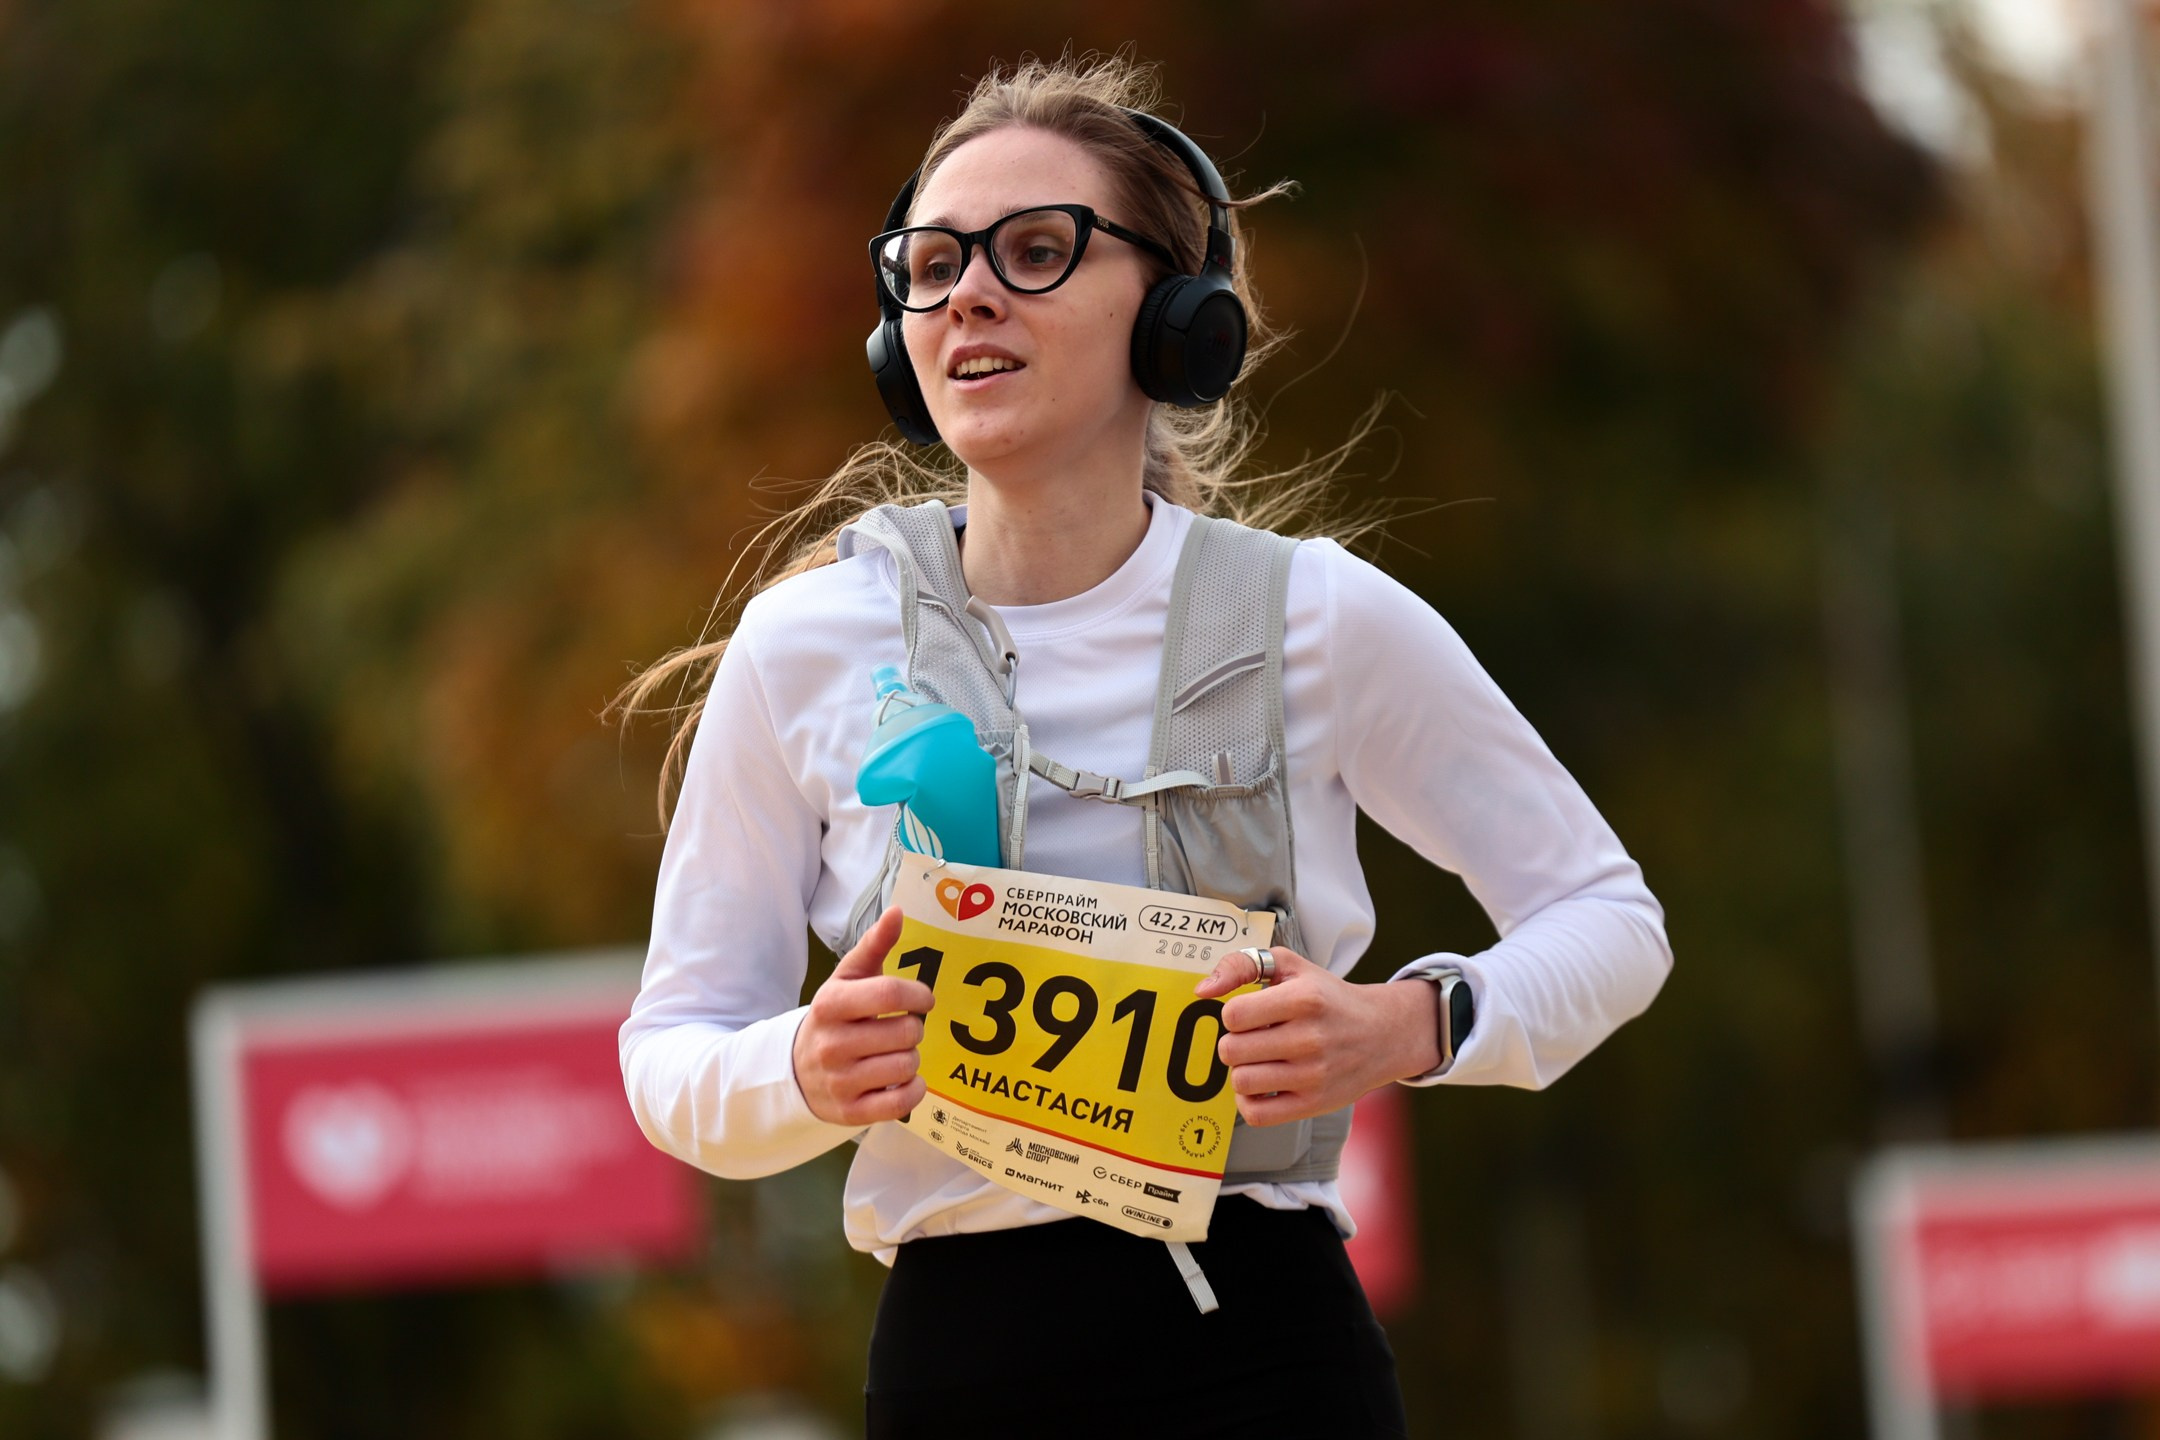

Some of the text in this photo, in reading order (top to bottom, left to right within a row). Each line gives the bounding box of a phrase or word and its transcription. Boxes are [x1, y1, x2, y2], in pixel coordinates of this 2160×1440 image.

[1006, 887, 1098, 909] СБЕРПРАЙМ
[1002, 901, 1128, 931] МОСКОВСКИЙ
[1149, 911, 1191, 931] 42,2
[998, 917, 1094, 945] МАРАФОН
[1155, 938, 1213, 961] 2026
[897, 946, 1231, 1103] 13910
[948, 1062, 1135, 1134] АНАСТАСИЯ
[1178, 1134, 1205, 1158] МАРАФОН
[1194, 1128, 1204, 1145] 1
[1197, 1115, 1221, 1155] МОСКОВСКИЙ
[968, 1153, 993, 1169] BRICS
[1025, 1150, 1051, 1165] СПОРТ
[1028, 1142, 1080, 1165] МОСКОВСКИЙ
[1015, 1171, 1065, 1192] магнит
[1109, 1173, 1175, 1199] СБЕР Прайм
[1092, 1197, 1109, 1207] сбп
[1125, 1207, 1162, 1224] WINLINE
